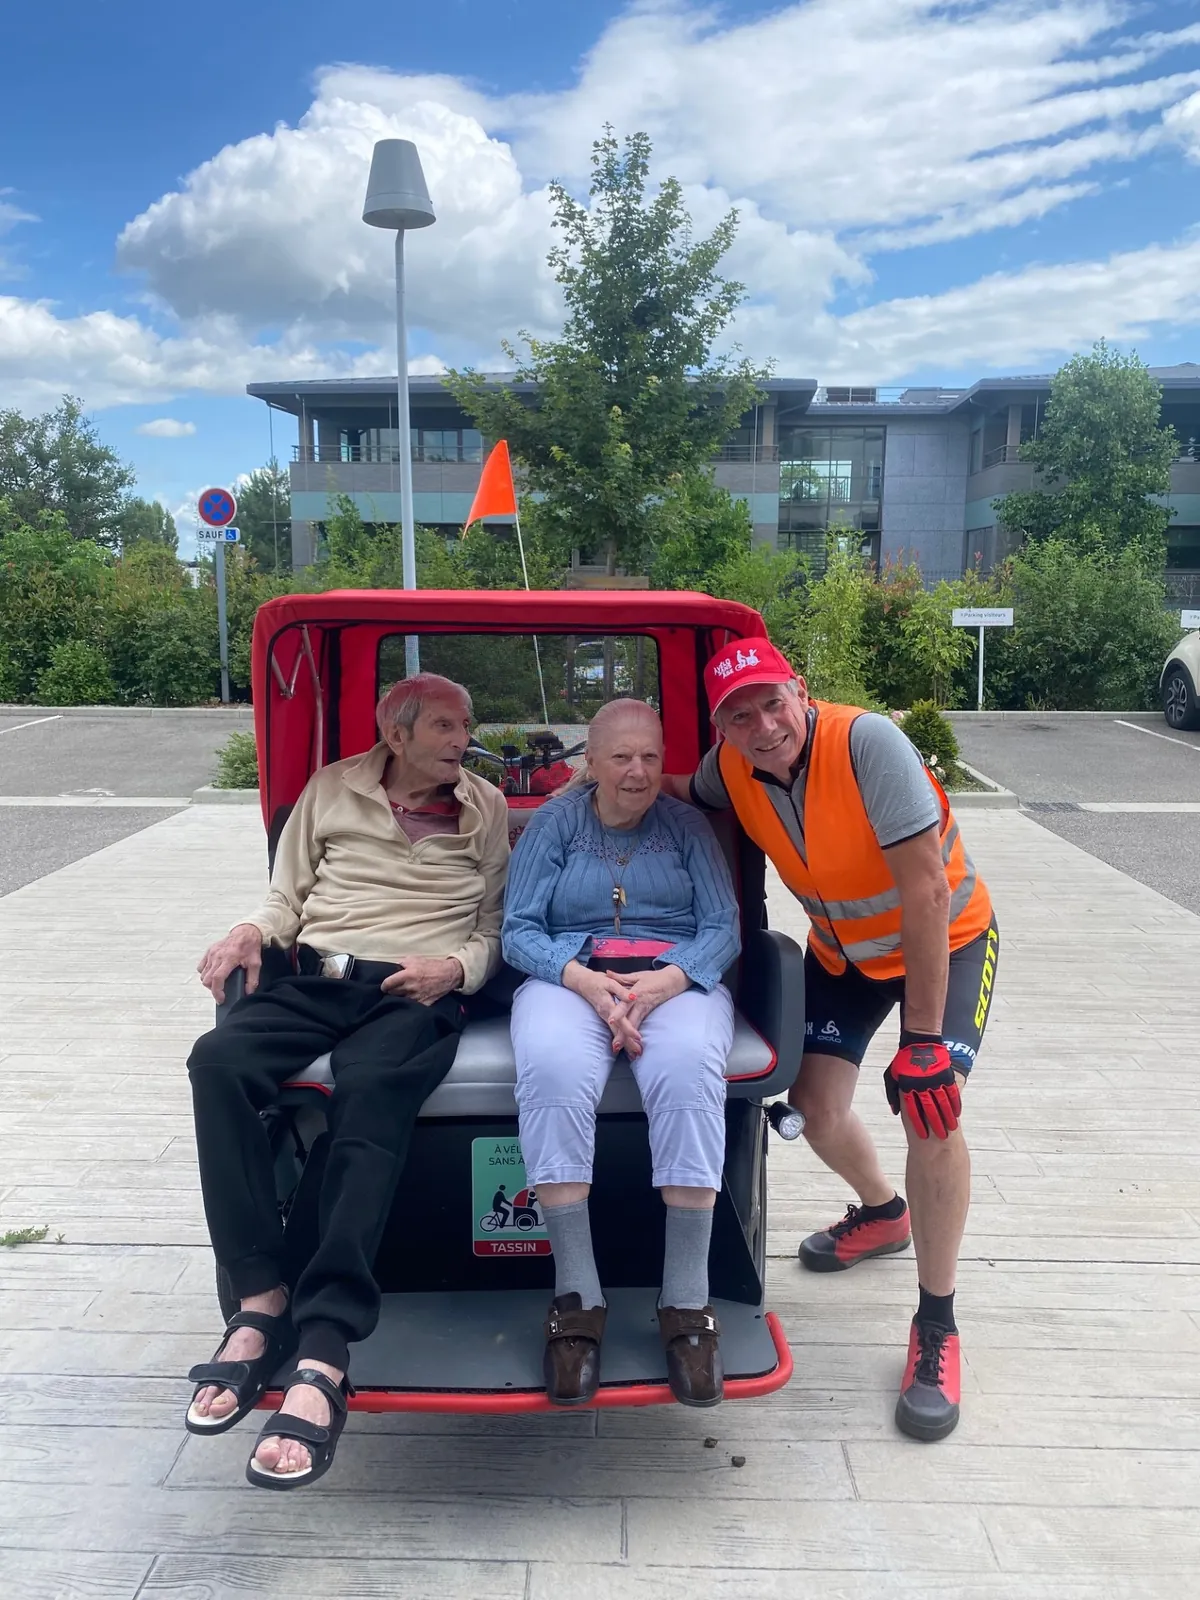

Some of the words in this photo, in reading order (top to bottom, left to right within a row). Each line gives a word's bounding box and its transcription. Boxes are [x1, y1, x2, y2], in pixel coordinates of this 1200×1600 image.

[198, 530, 224, 539] SAUF
[503, 1143, 522, 1154] VÉL
[488, 1157, 516, 1166] SANS
[490, 1242, 537, 1253] TASSIN
